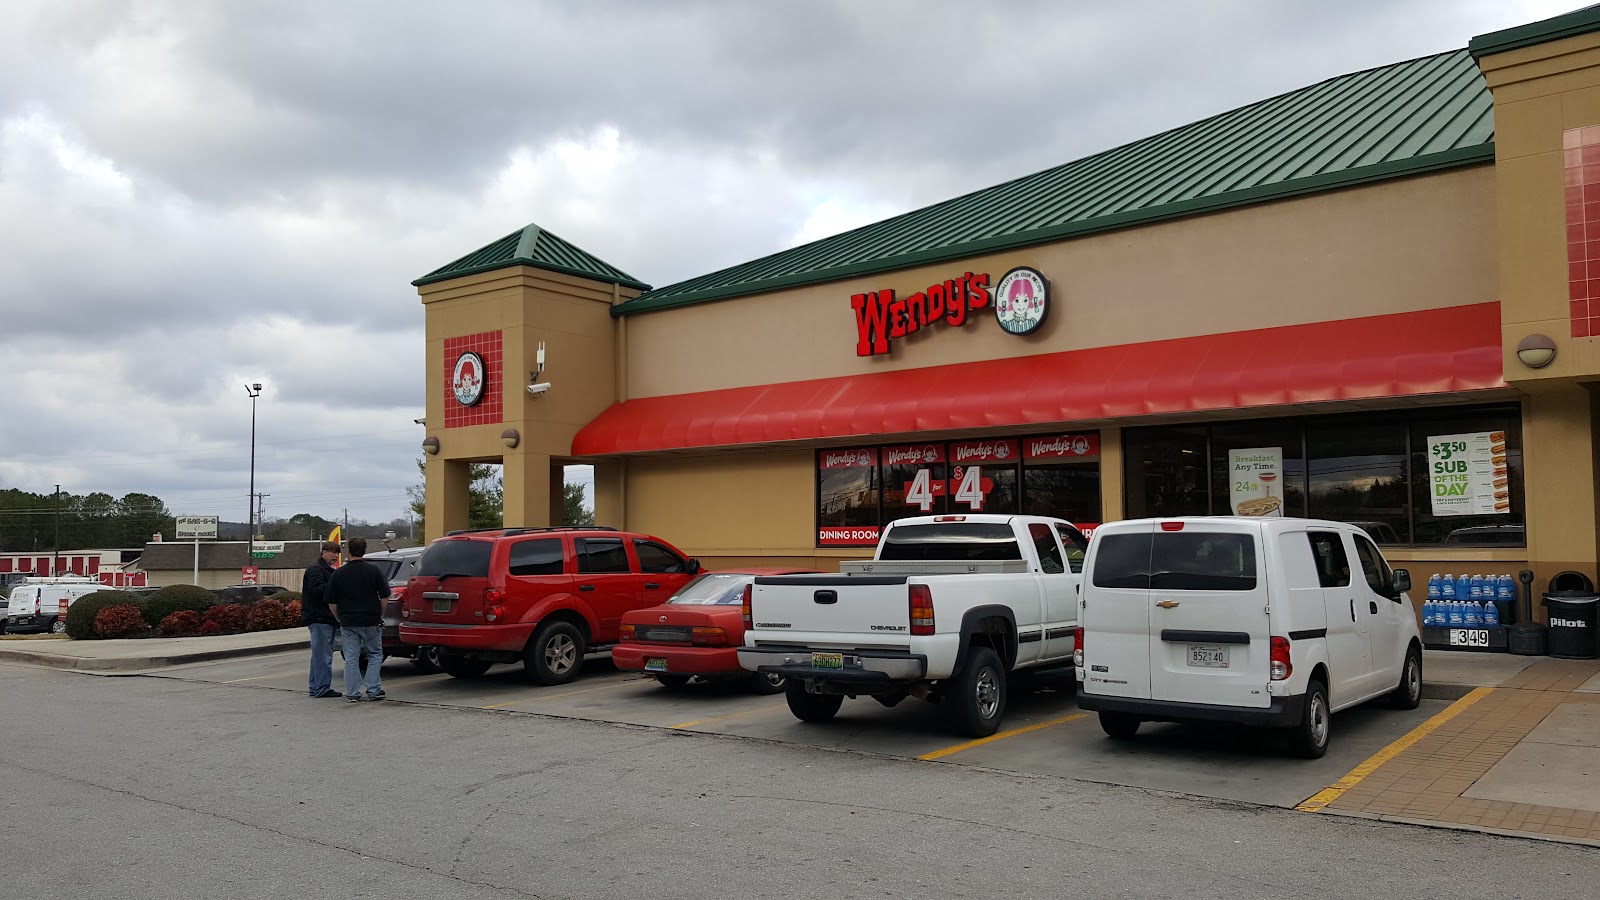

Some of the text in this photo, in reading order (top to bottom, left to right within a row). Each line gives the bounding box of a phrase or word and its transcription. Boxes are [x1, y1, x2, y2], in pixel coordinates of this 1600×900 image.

[999, 276, 1013, 297] QUALITY
[851, 272, 989, 357] Wendy's
[888, 447, 922, 464] Wendy's
[956, 443, 992, 461] Wendy's
[1031, 438, 1070, 457] Wendy's
[826, 451, 856, 468] Wendy's
[1235, 455, 1276, 463] Breakfast,
[1434, 460, 1468, 474] SUB
[1235, 464, 1252, 472] Any
[1434, 474, 1469, 483] OF THE
[905, 468, 934, 511] 4
[932, 484, 942, 492] for
[1435, 482, 1469, 497] DAY
[819, 530, 879, 540] DINING ROOM
[1193, 651, 1207, 661] 852
[1213, 652, 1224, 662] 40
